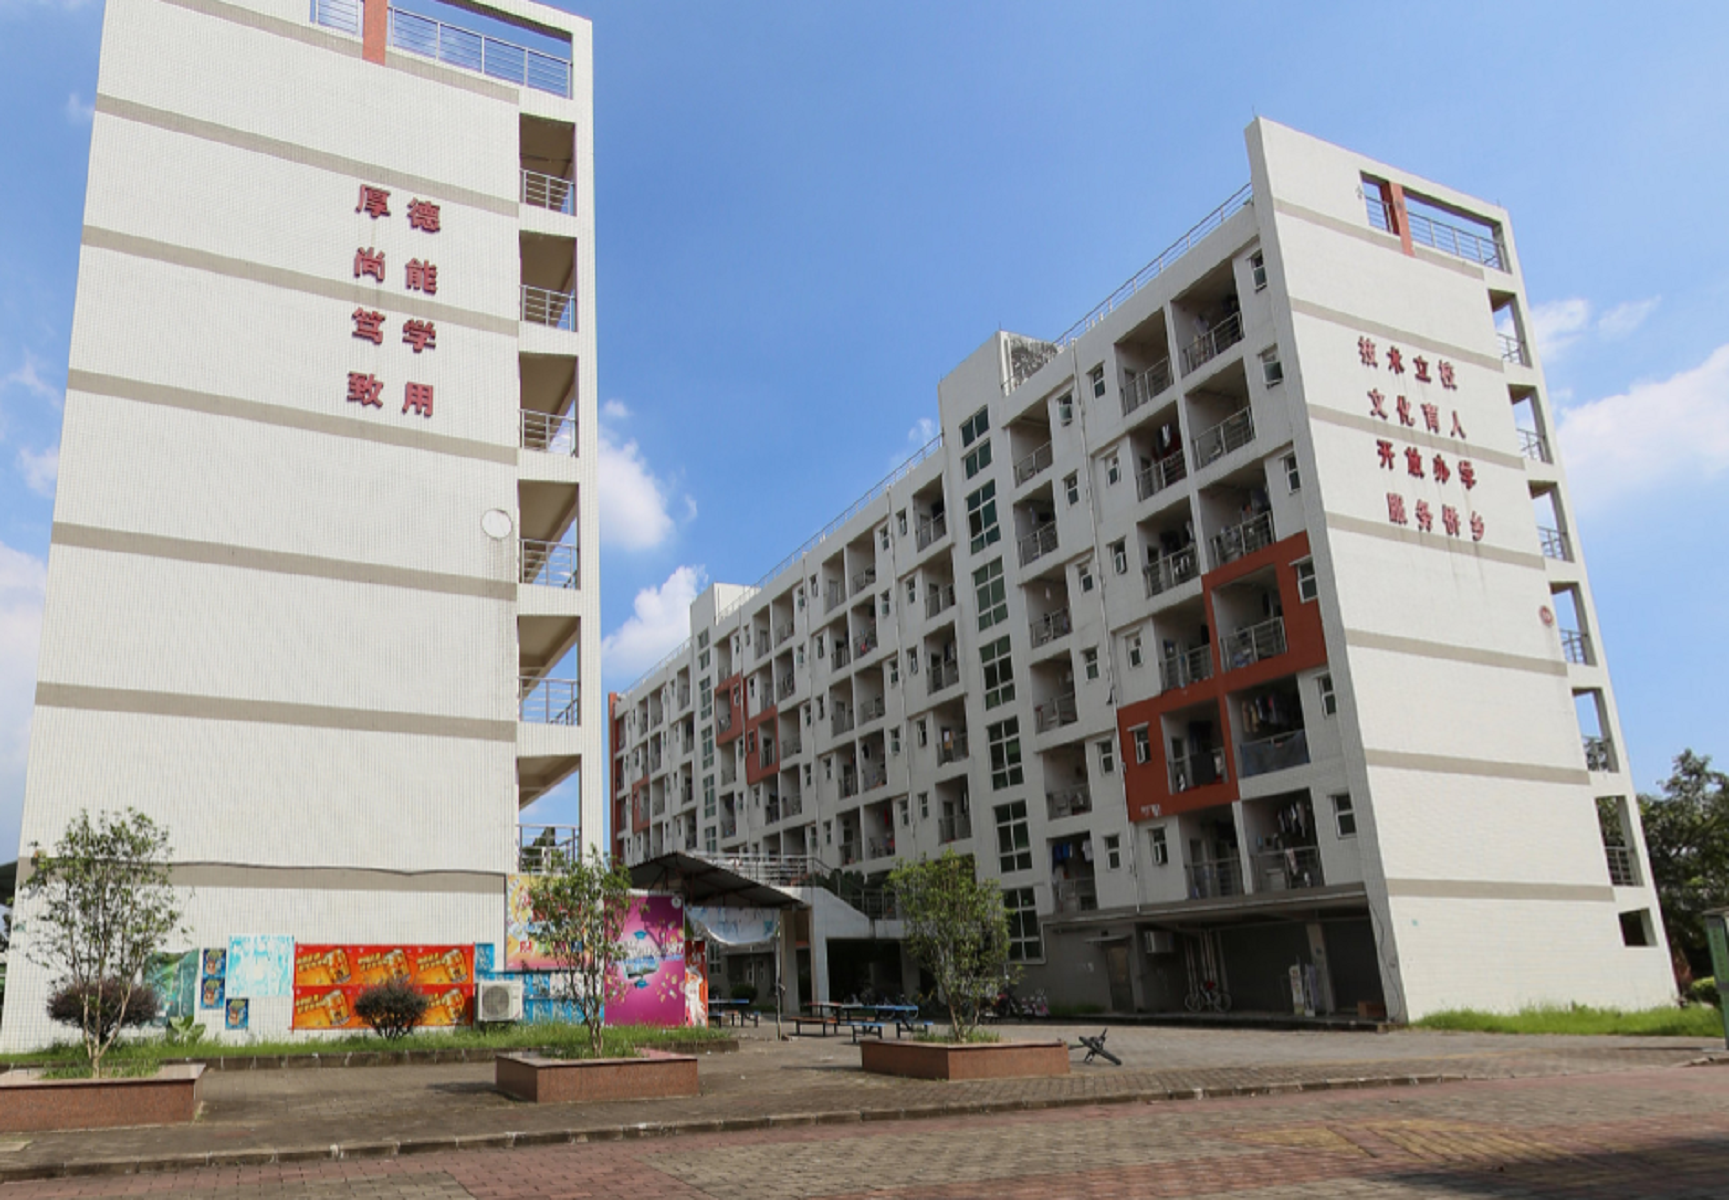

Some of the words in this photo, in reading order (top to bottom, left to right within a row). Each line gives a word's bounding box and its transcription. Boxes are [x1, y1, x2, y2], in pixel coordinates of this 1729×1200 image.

[355, 184, 440, 233] 厚德
[354, 247, 437, 294] 尚能
[352, 307, 436, 353] 笃学
[1358, 336, 1457, 390] 技术立校
[347, 371, 434, 417] 致用
[1367, 388, 1467, 439] 文化育人
[1377, 439, 1477, 490] 开放办学
